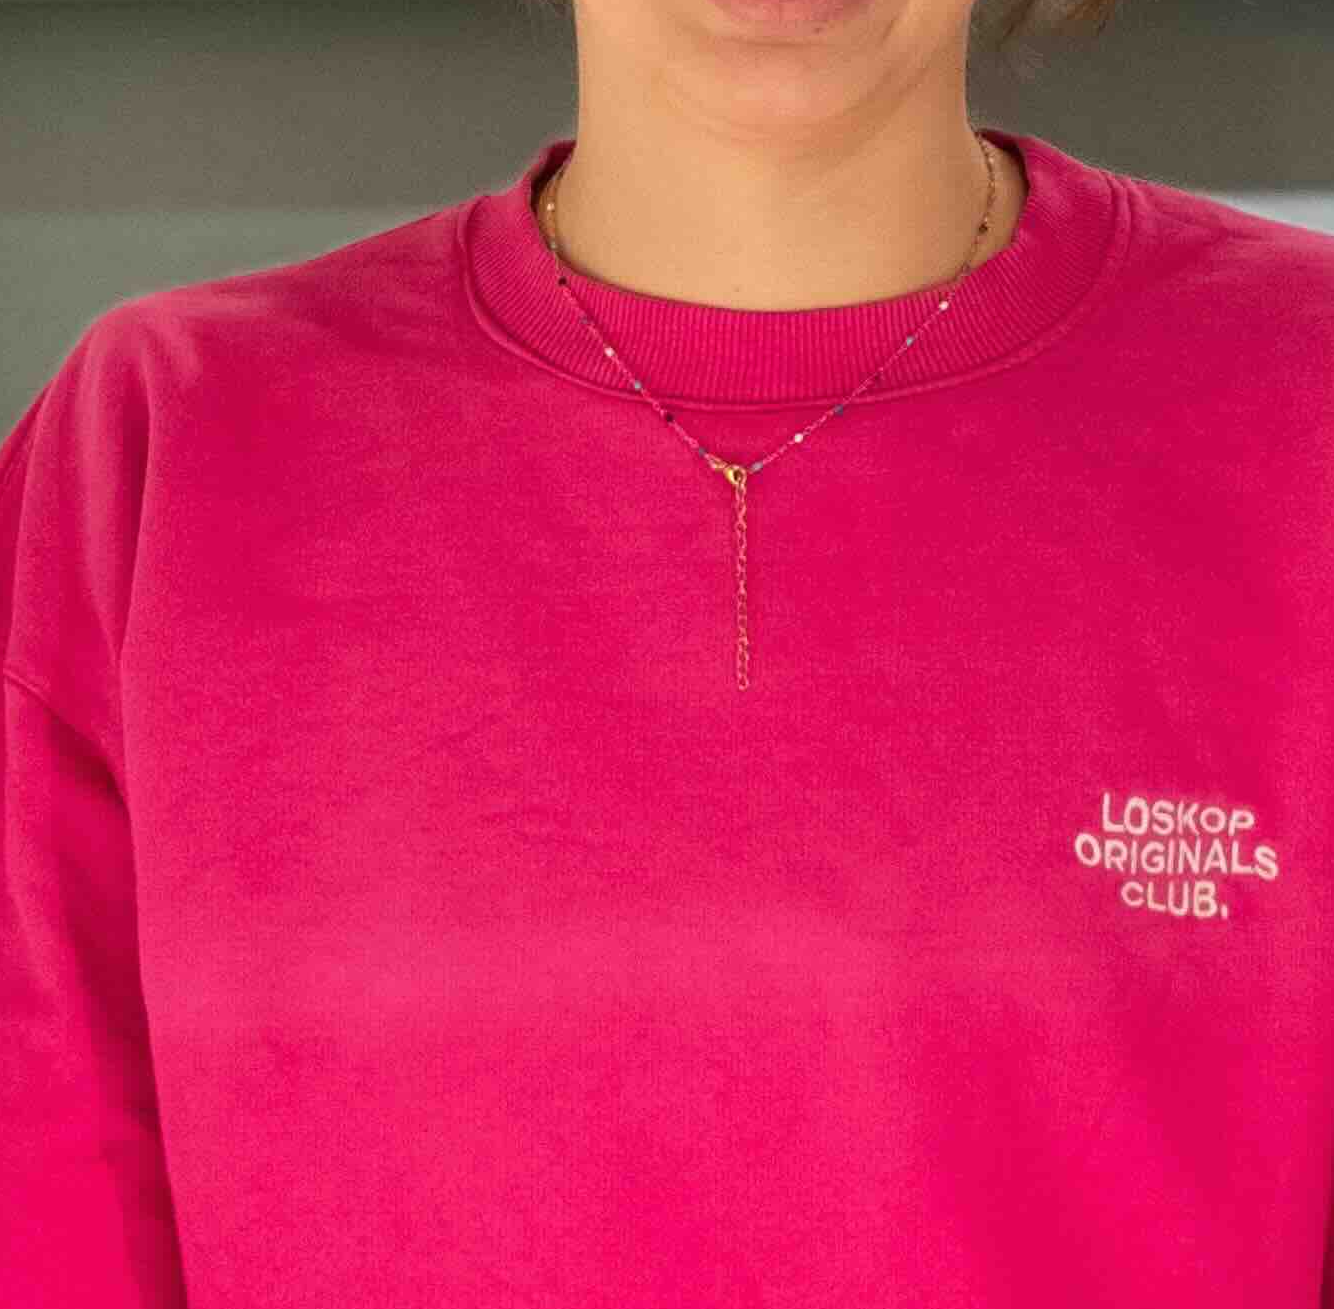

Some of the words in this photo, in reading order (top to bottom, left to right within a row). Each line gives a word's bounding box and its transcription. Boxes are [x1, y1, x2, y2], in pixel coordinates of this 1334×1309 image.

[1101, 792, 1255, 837] LOSKOP
[1074, 832, 1279, 880] ORIGINALS
[1121, 880, 1229, 920] CLUB.
